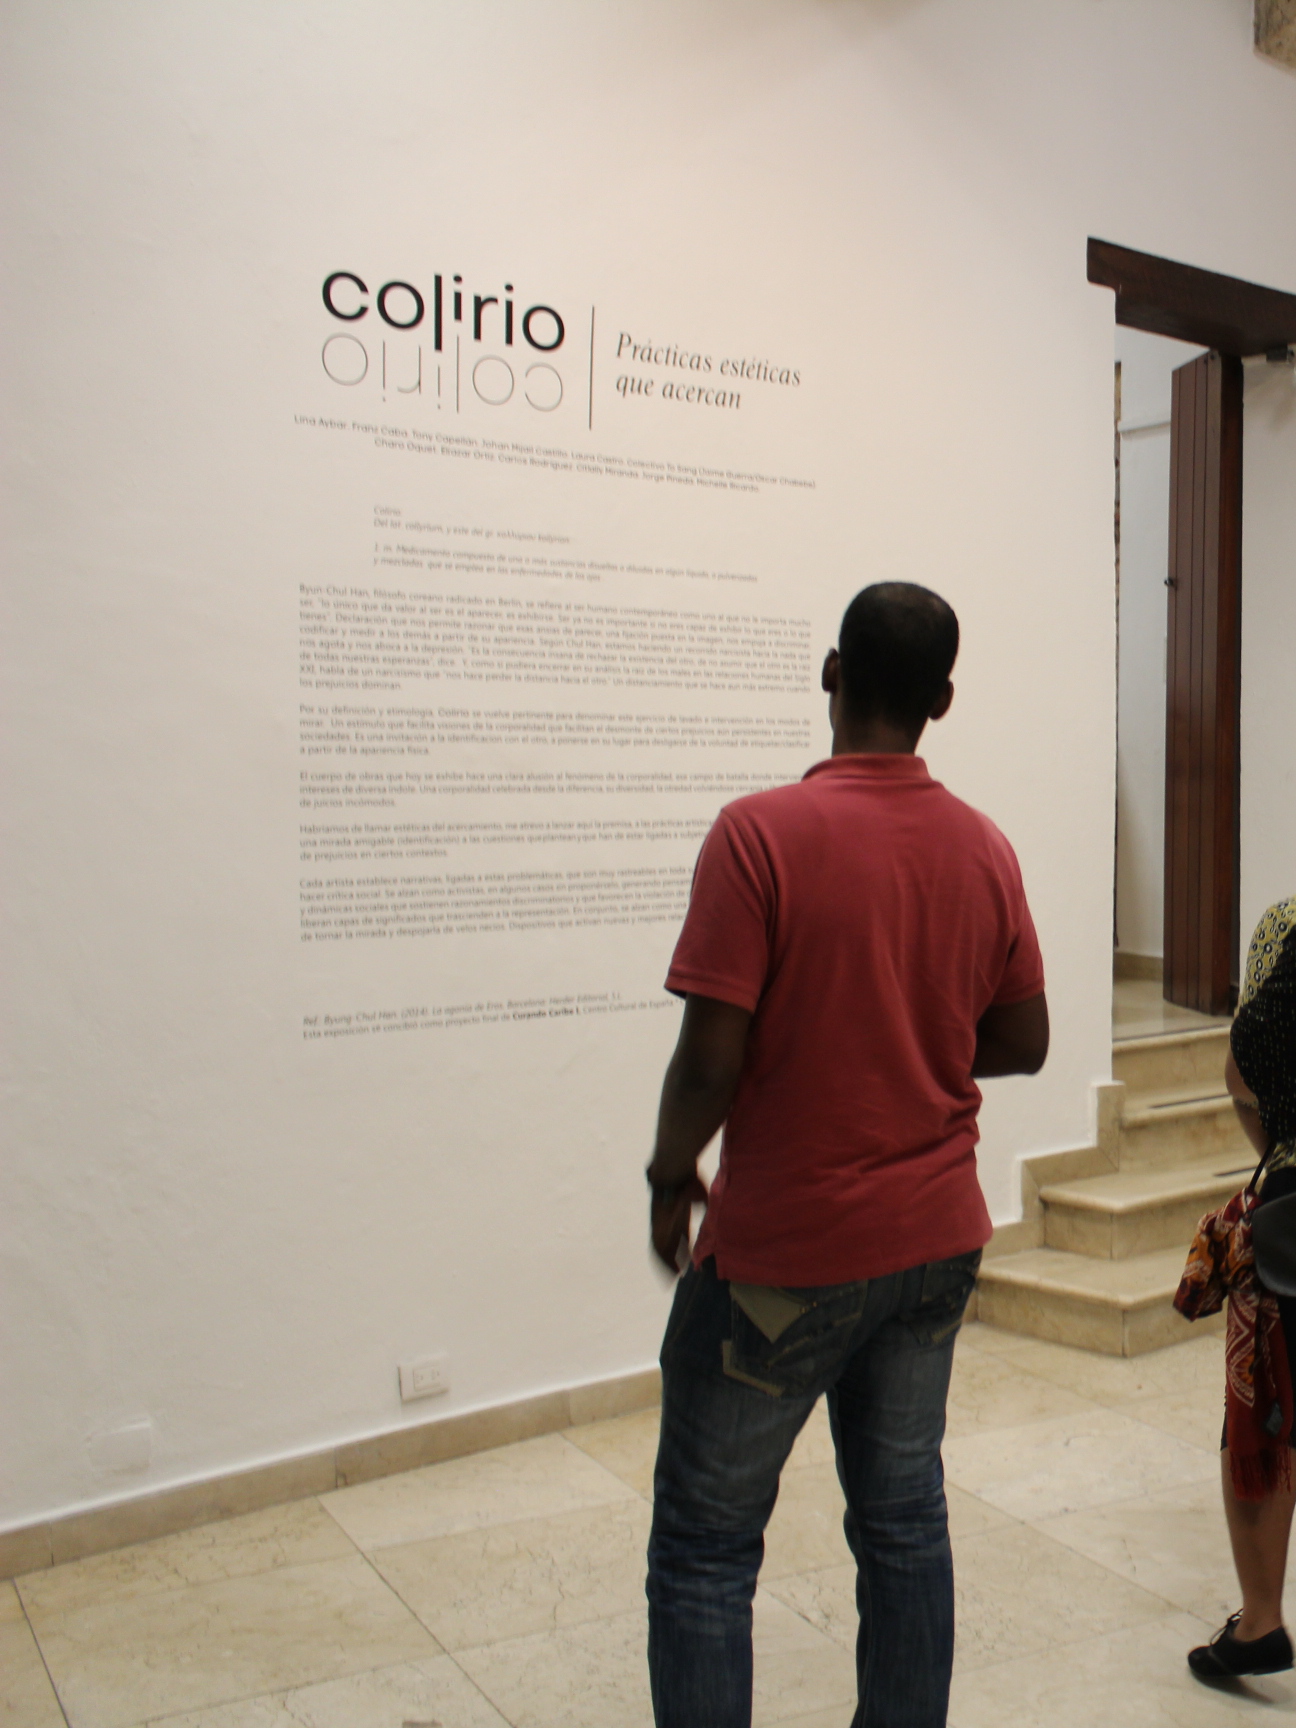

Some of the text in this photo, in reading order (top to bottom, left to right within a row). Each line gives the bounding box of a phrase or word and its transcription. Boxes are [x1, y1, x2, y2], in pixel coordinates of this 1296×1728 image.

[321, 271, 566, 353] colirio
[616, 331, 802, 388] Prácticas estéticas
[615, 371, 742, 410] que acercan
